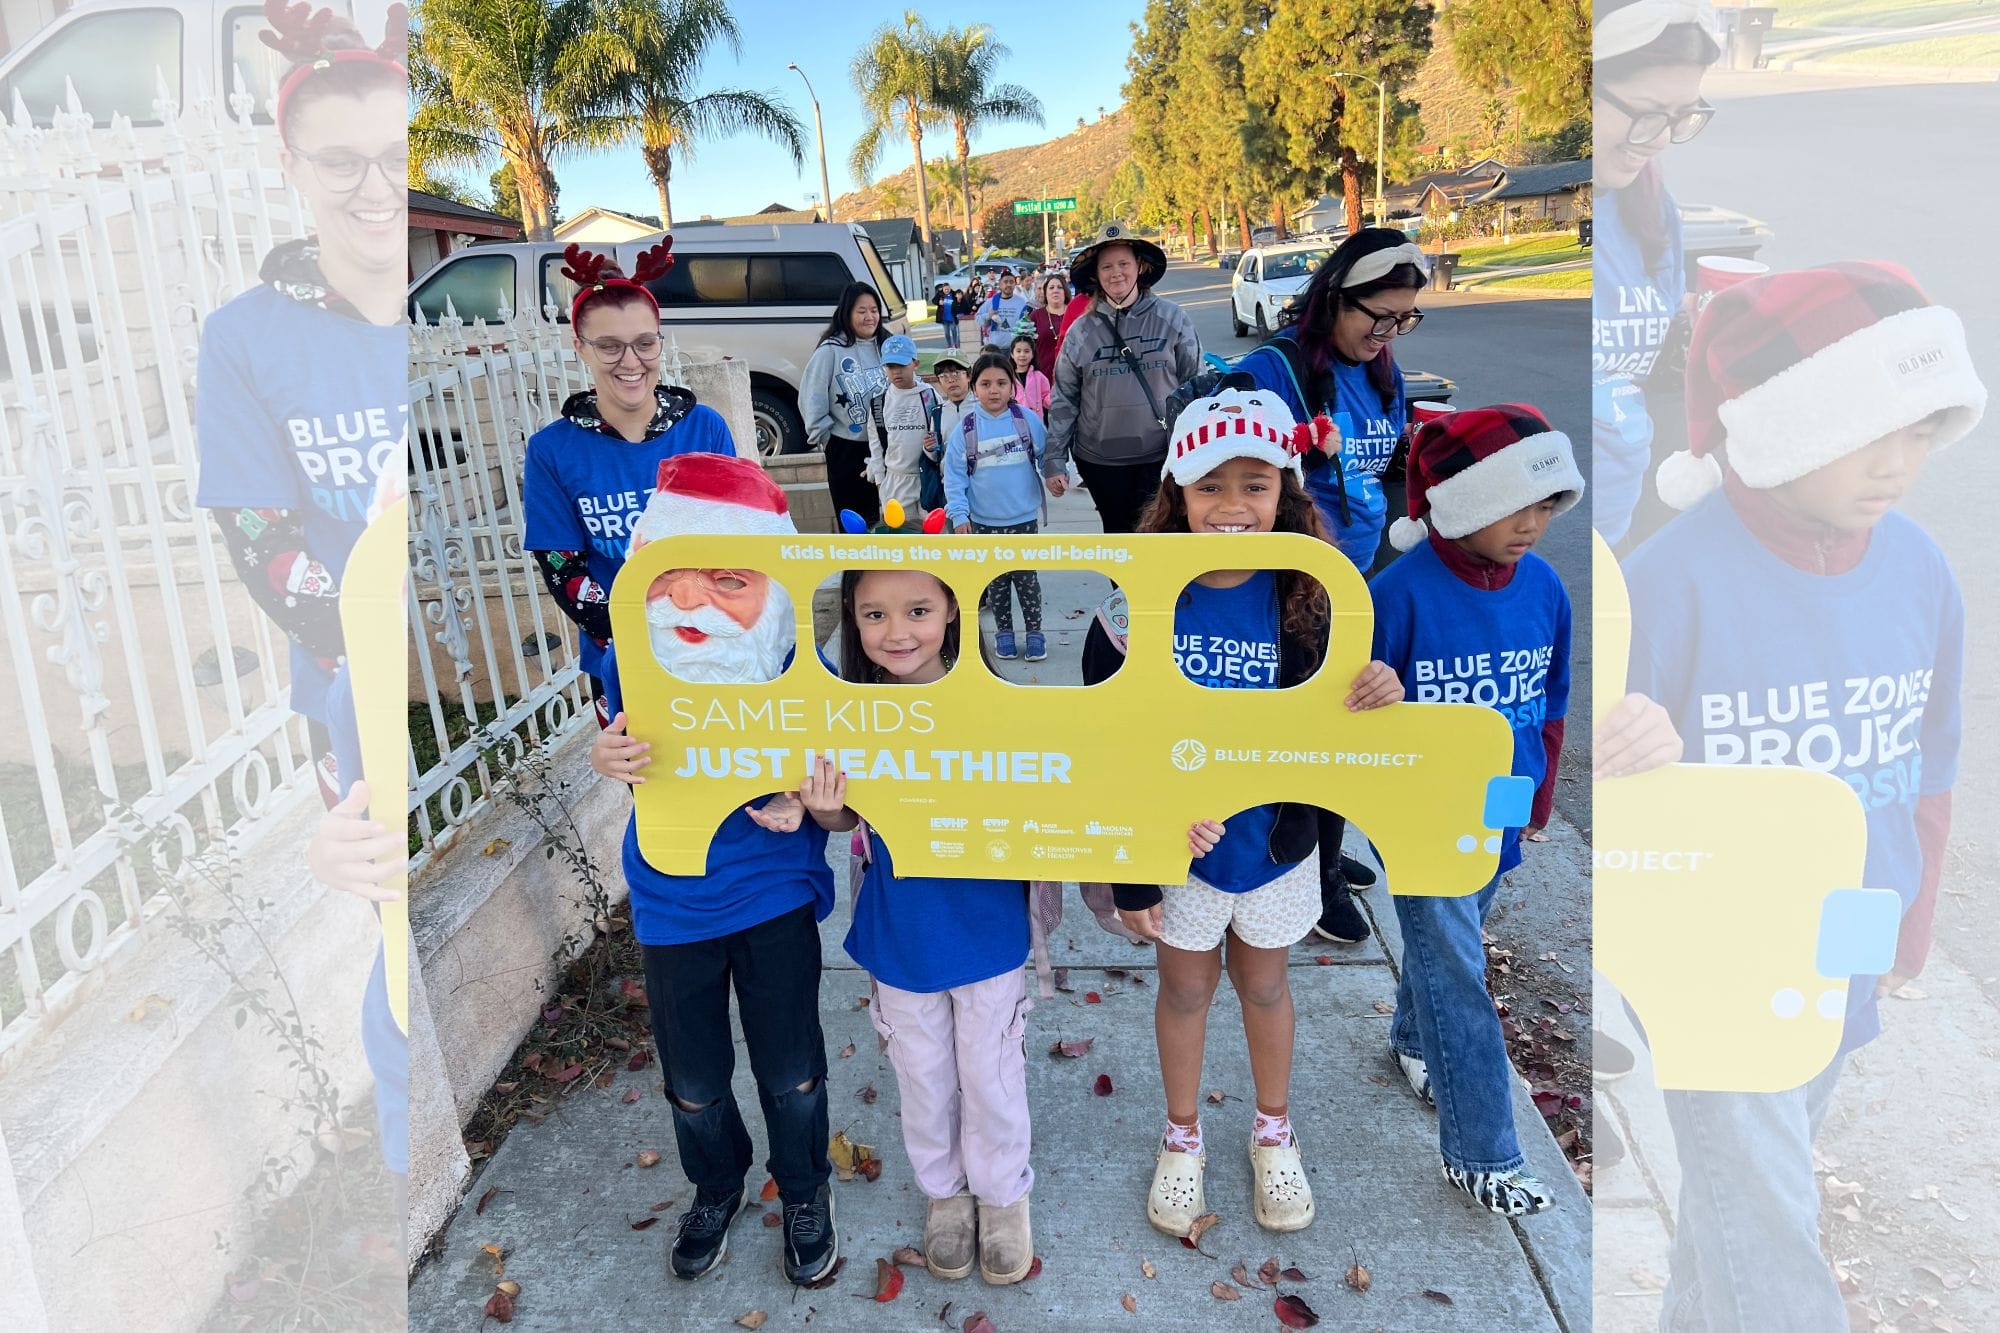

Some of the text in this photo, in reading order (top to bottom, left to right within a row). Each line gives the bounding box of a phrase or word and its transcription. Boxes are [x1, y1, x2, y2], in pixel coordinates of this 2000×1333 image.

[1015, 202, 1041, 212] Westfall
[1898, 349, 1944, 375] OLD NAVY
[288, 408, 391, 447] BLUE
[578, 491, 639, 515] BLUE
[780, 544, 1134, 563] Kids leading the way to well-being.
[1209, 636, 1278, 660] ZONES
[1415, 645, 1554, 682] BLUE ZONES
[1701, 668, 1934, 729] BLUE ZONES
[670, 697, 935, 733] SAME KIDS
[674, 747, 790, 779] JUST
[1215, 749, 1261, 762] BLUE
[1266, 750, 1330, 764] ZONES
